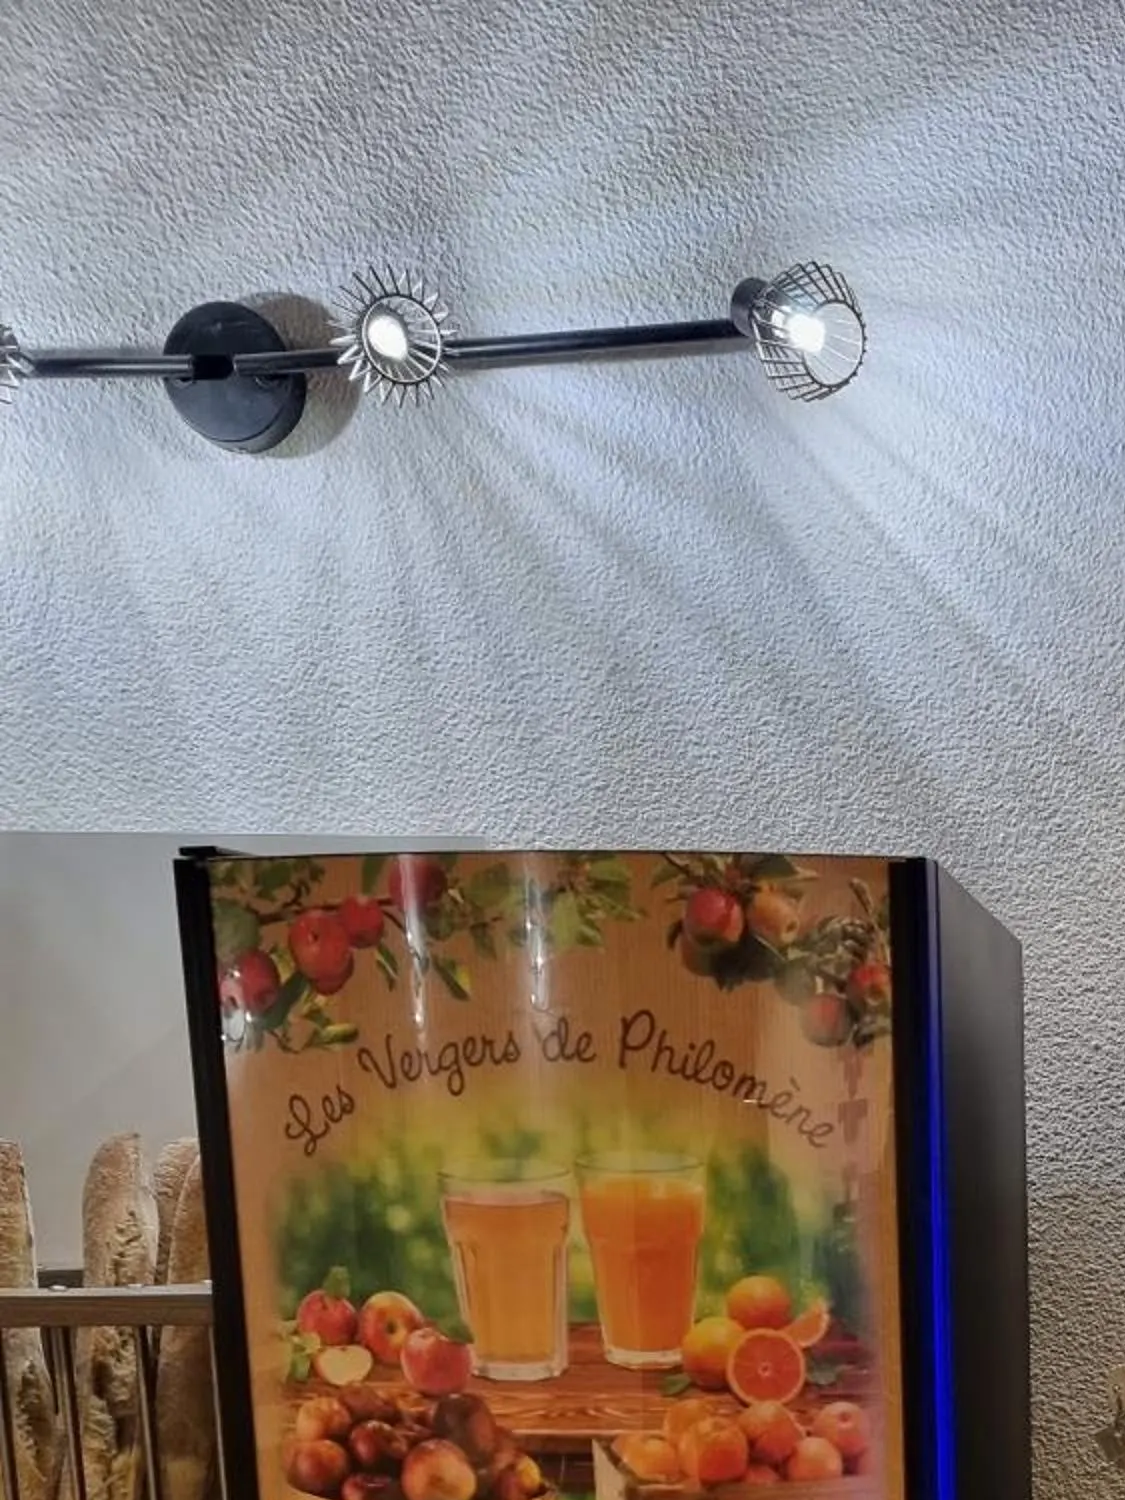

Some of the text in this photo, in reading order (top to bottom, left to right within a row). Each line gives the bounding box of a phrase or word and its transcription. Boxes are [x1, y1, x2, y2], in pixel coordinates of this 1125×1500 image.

[284, 1008, 837, 1156] Les Vergers de Philomène
